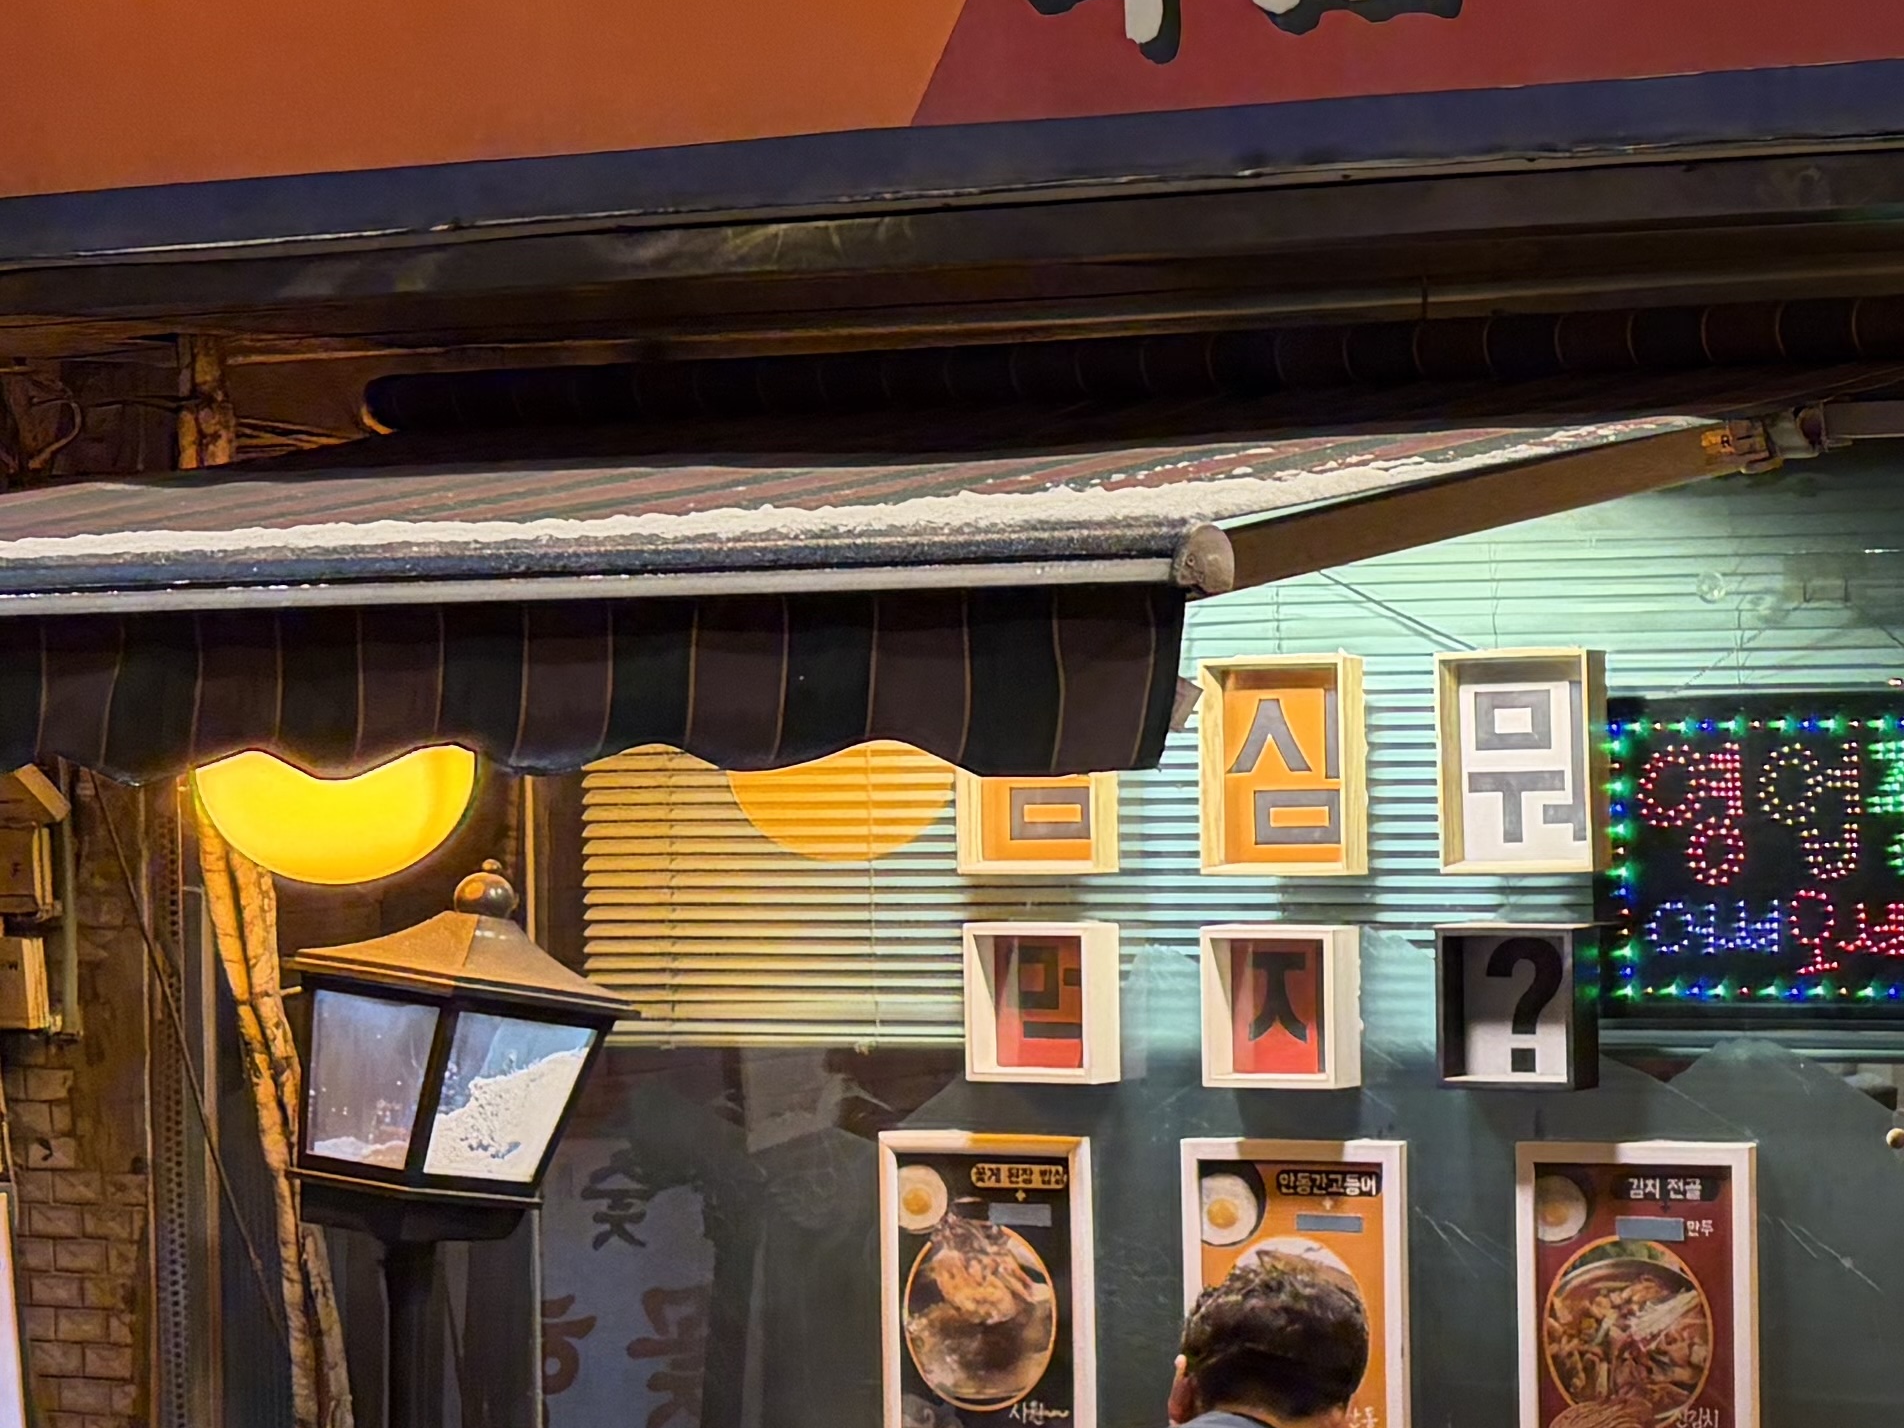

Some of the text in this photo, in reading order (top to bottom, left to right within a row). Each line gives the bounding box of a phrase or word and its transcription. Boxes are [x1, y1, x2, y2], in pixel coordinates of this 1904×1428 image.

[1279, 1172, 1377, 1197] 안동간고등어
[1627, 1177, 1703, 1201] 김치 전골
[1686, 1219, 1714, 1238] 만두
